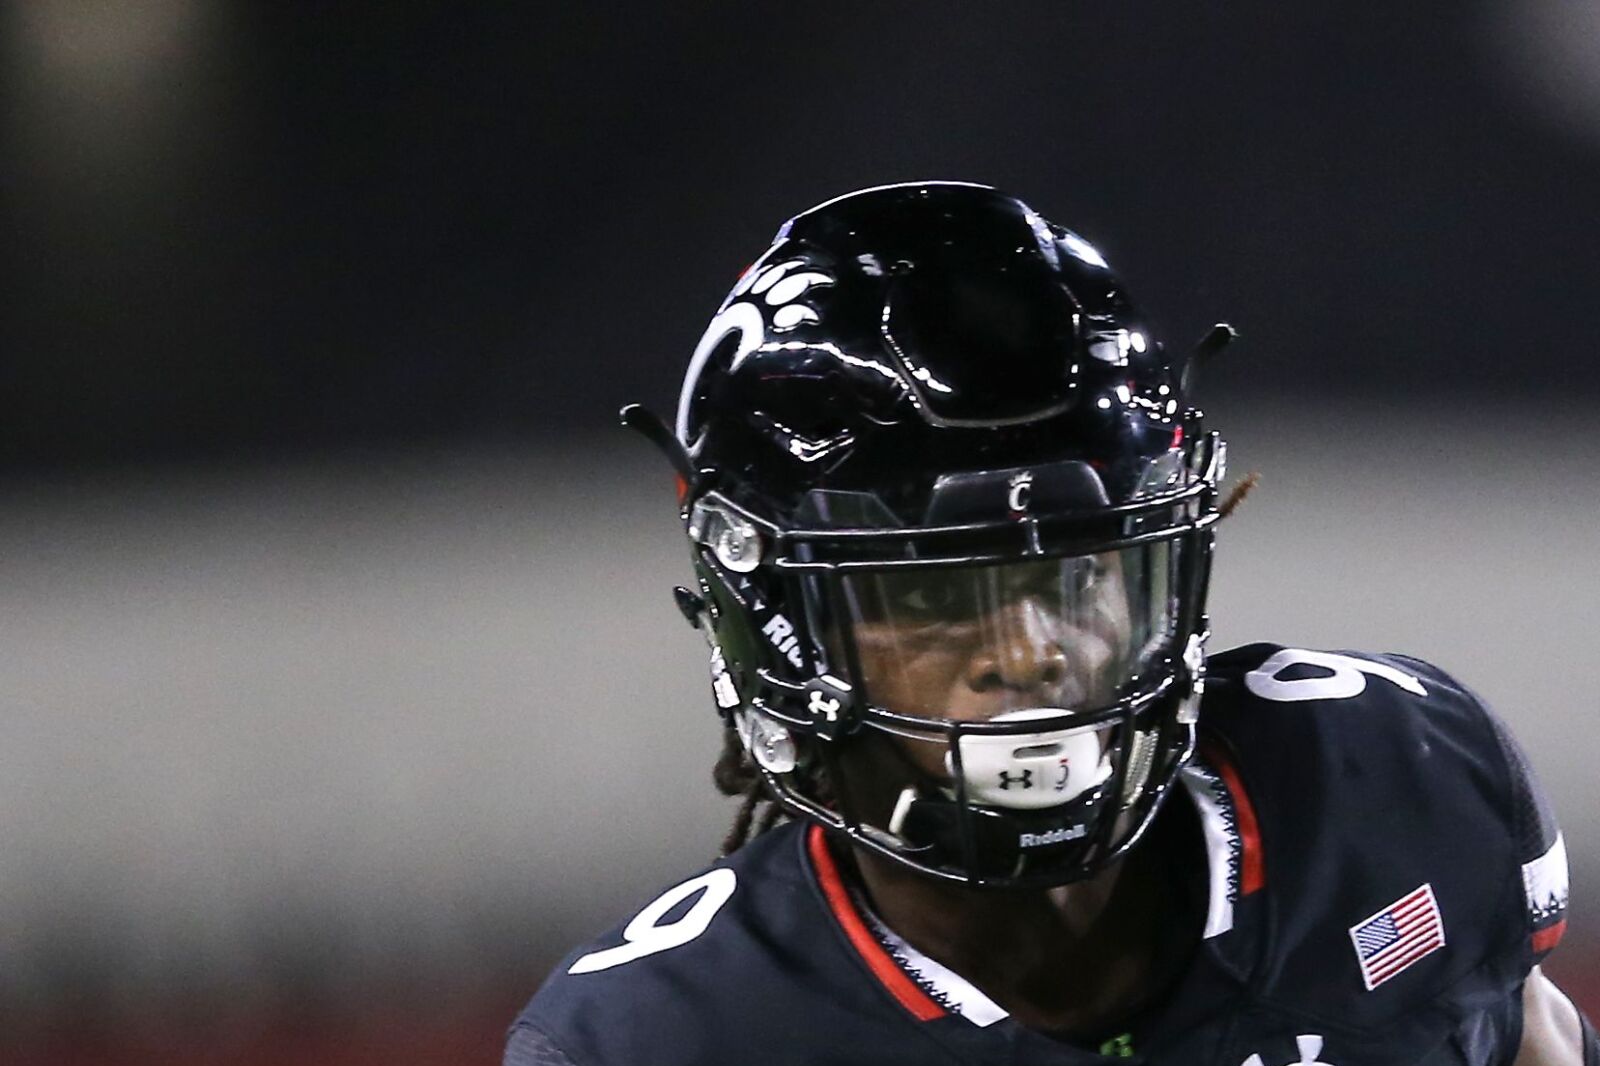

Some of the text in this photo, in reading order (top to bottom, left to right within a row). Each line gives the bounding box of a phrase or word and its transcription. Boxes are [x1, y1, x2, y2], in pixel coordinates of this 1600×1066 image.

[1245, 648, 1428, 701] 9
[1019, 824, 1086, 848] Riddell
[567, 867, 737, 975] 9
